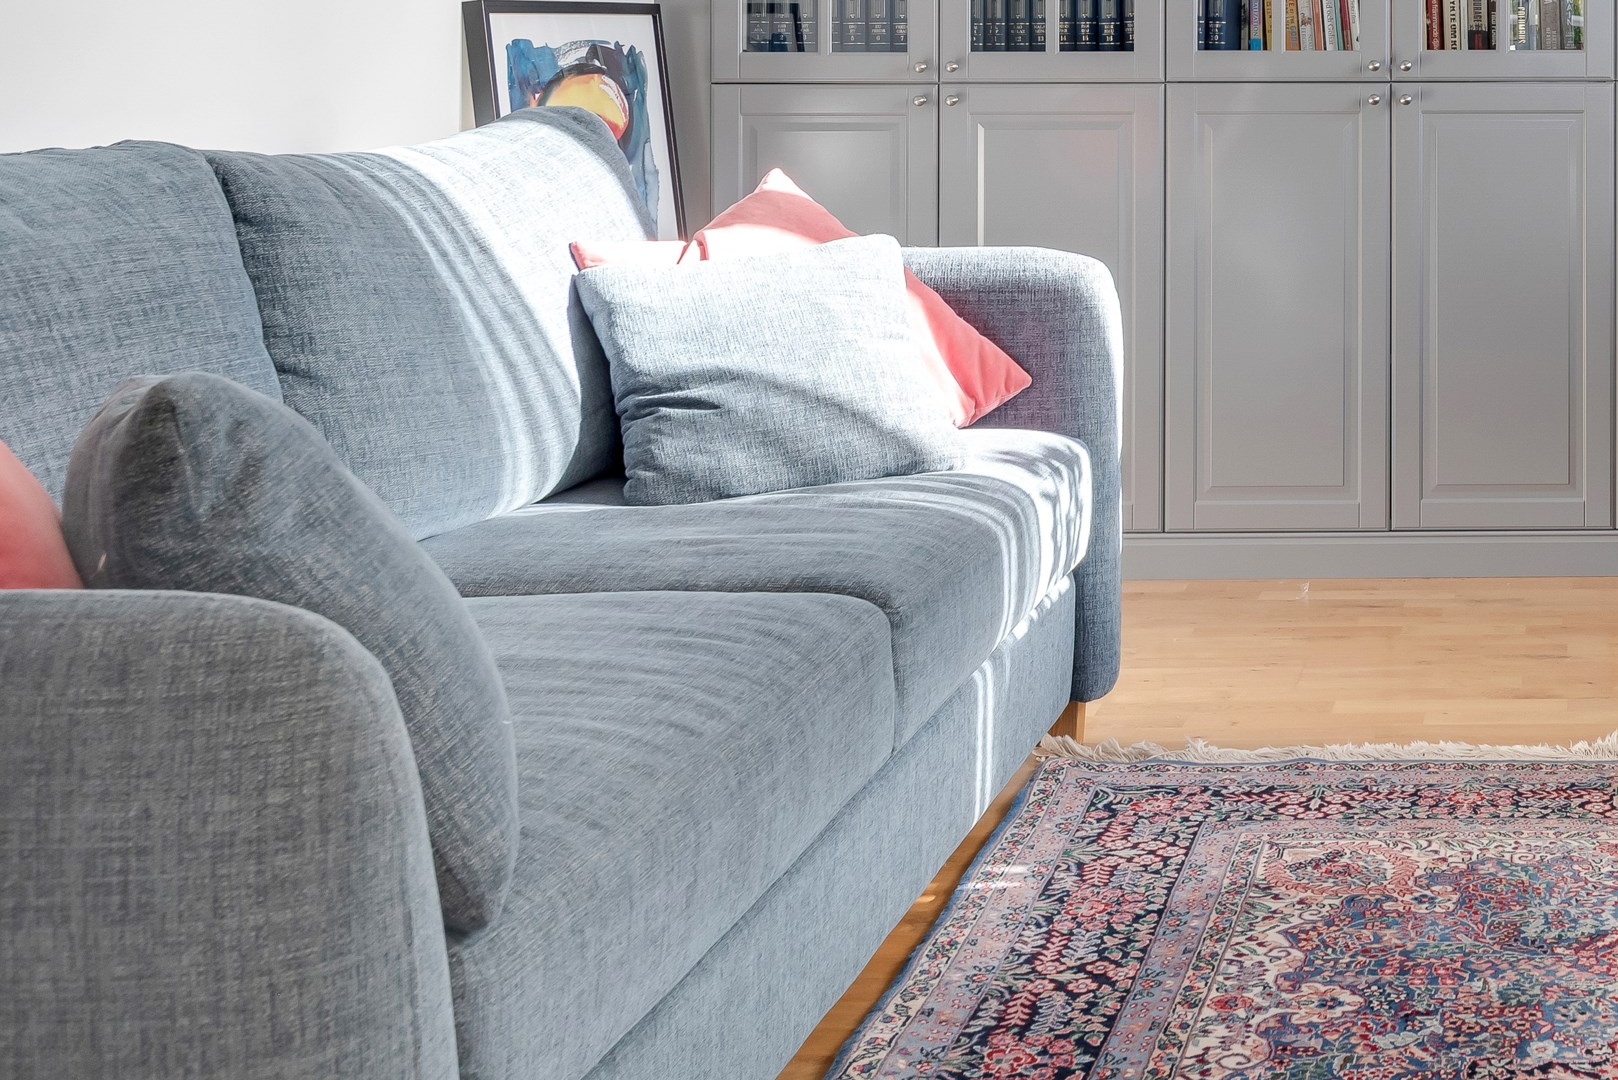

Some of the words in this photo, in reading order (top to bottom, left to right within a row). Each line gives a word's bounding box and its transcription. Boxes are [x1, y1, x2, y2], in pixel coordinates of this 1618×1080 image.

[1326, 11, 1334, 23] och
[1517, 6, 1527, 44] COLUMBUS
[1327, 24, 1335, 46] Goliat
[1450, 23, 1458, 39] OM
